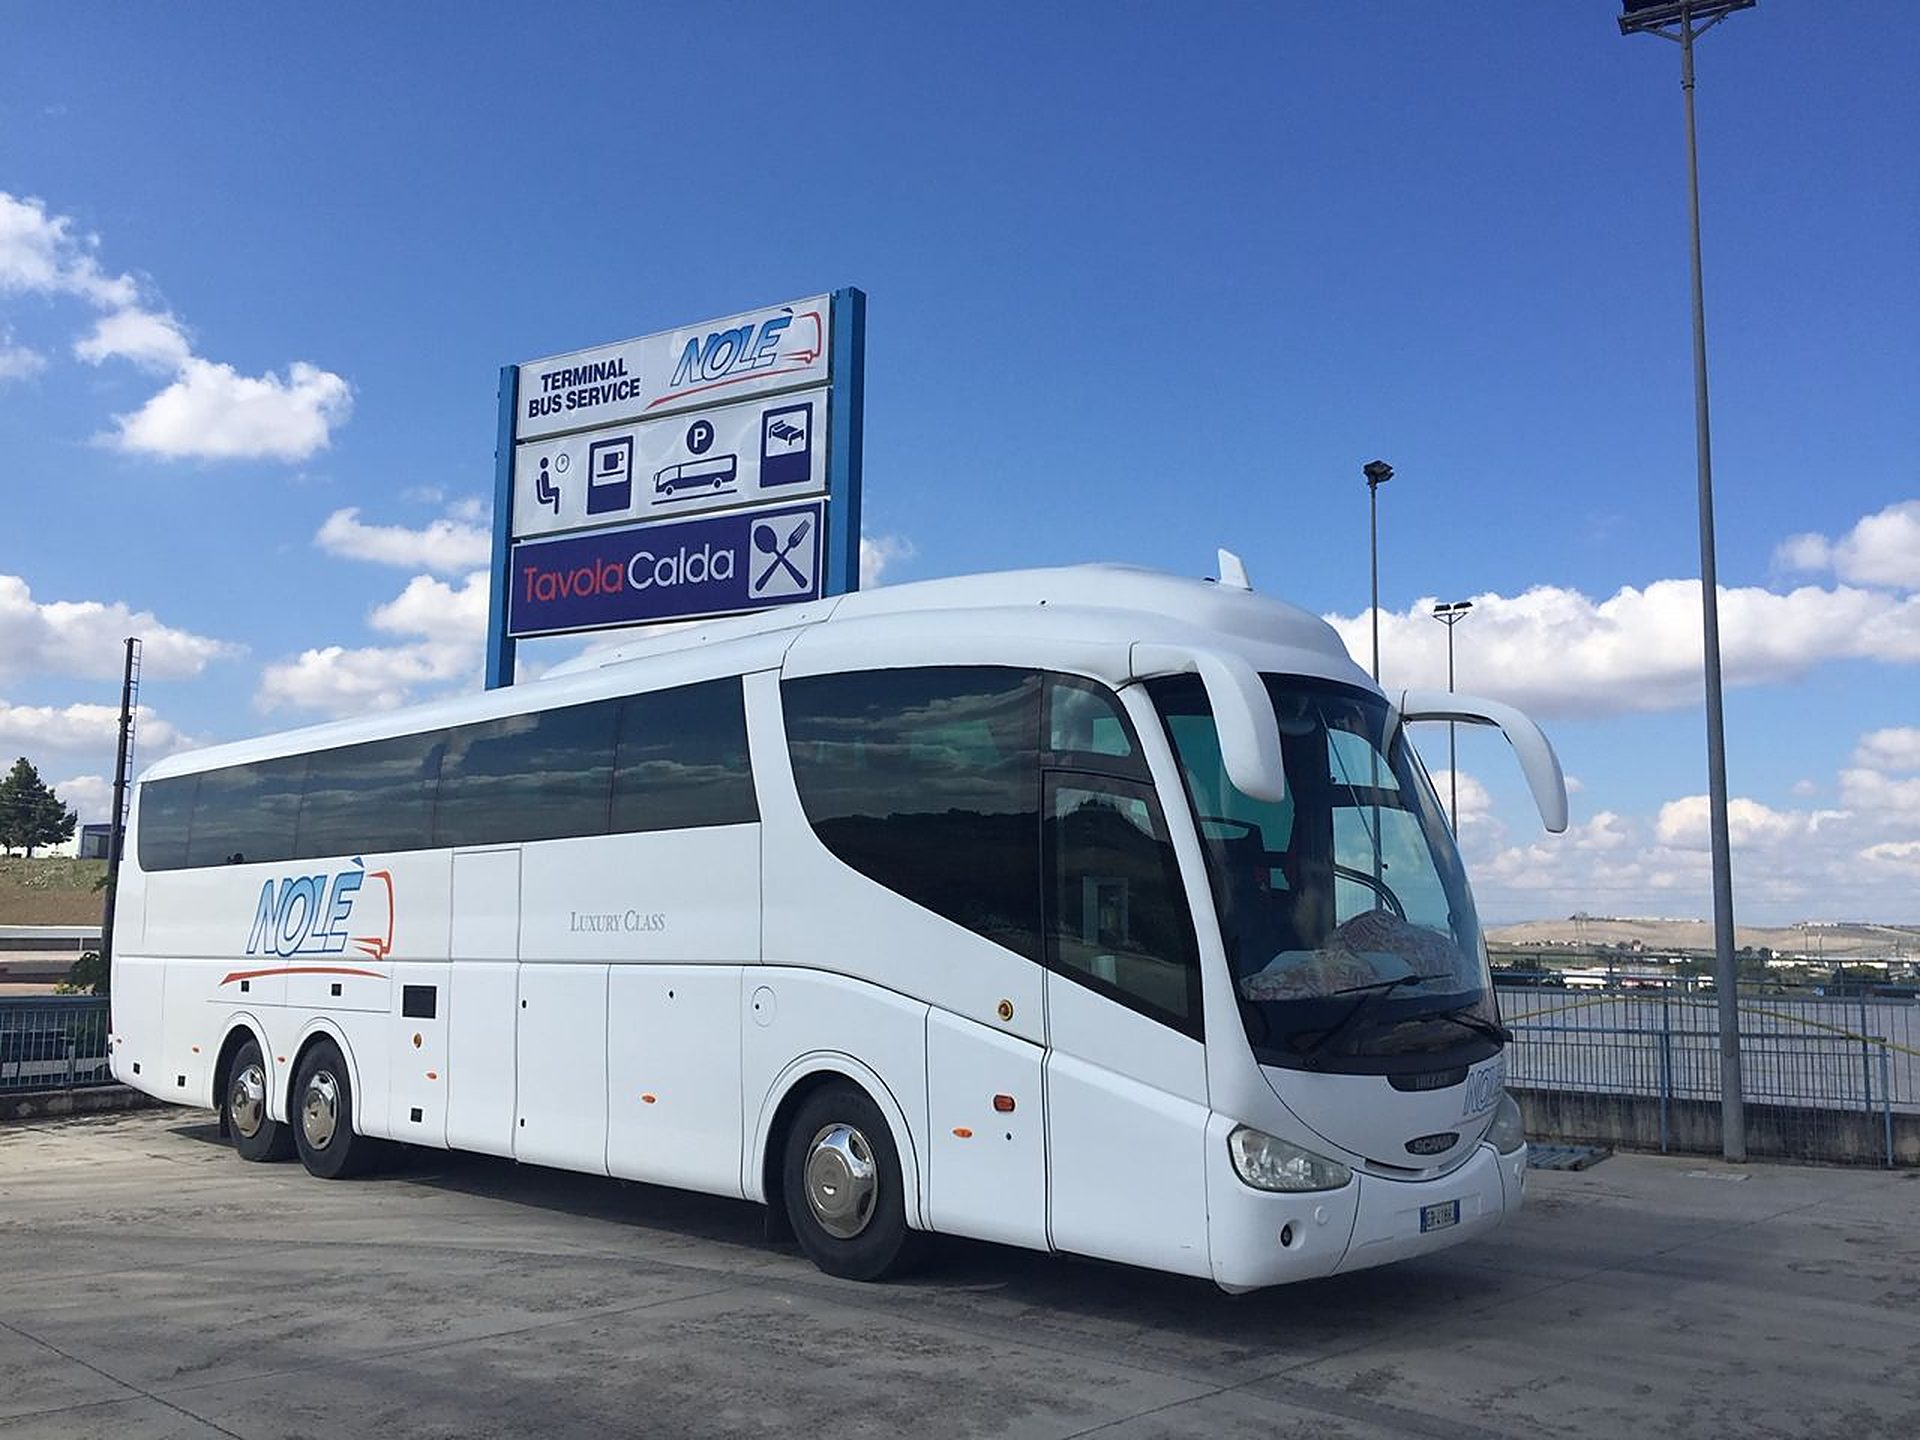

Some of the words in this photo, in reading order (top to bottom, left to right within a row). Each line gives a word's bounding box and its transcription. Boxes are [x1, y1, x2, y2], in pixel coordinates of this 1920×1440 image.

[541, 358, 628, 392] TERMINAL
[528, 394, 562, 418] BUS
[566, 377, 641, 410] SERVICE
[694, 428, 707, 448] P
